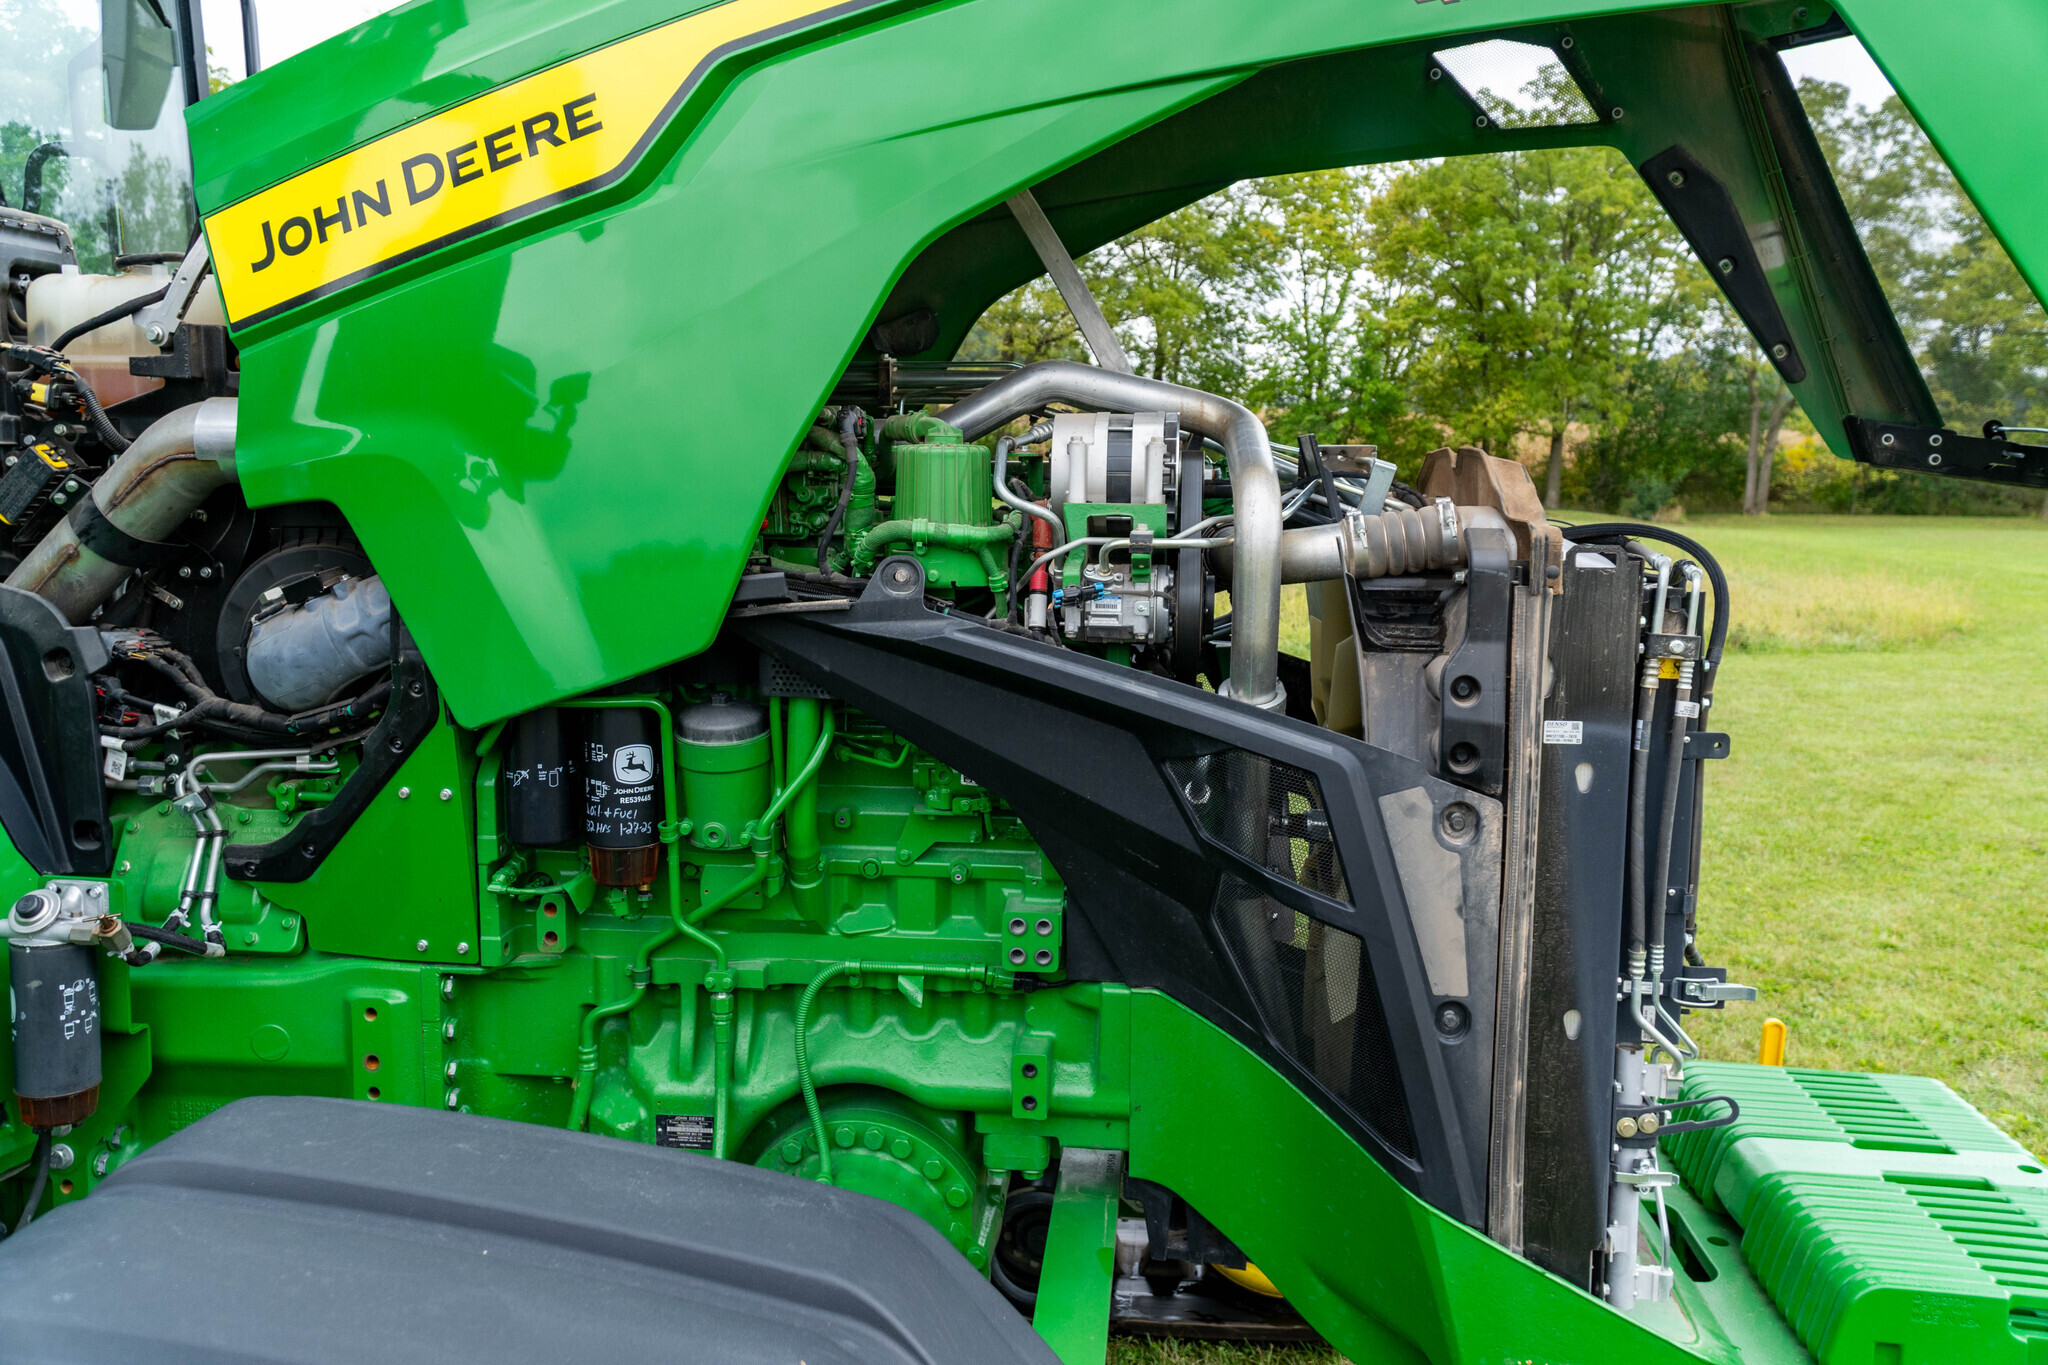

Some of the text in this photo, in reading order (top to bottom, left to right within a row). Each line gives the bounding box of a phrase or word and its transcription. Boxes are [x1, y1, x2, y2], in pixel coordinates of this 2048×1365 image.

[251, 92, 603, 273] JOHN DEERE
[613, 784, 655, 795] JOHN DEERE
[620, 794, 652, 804] RE539465
